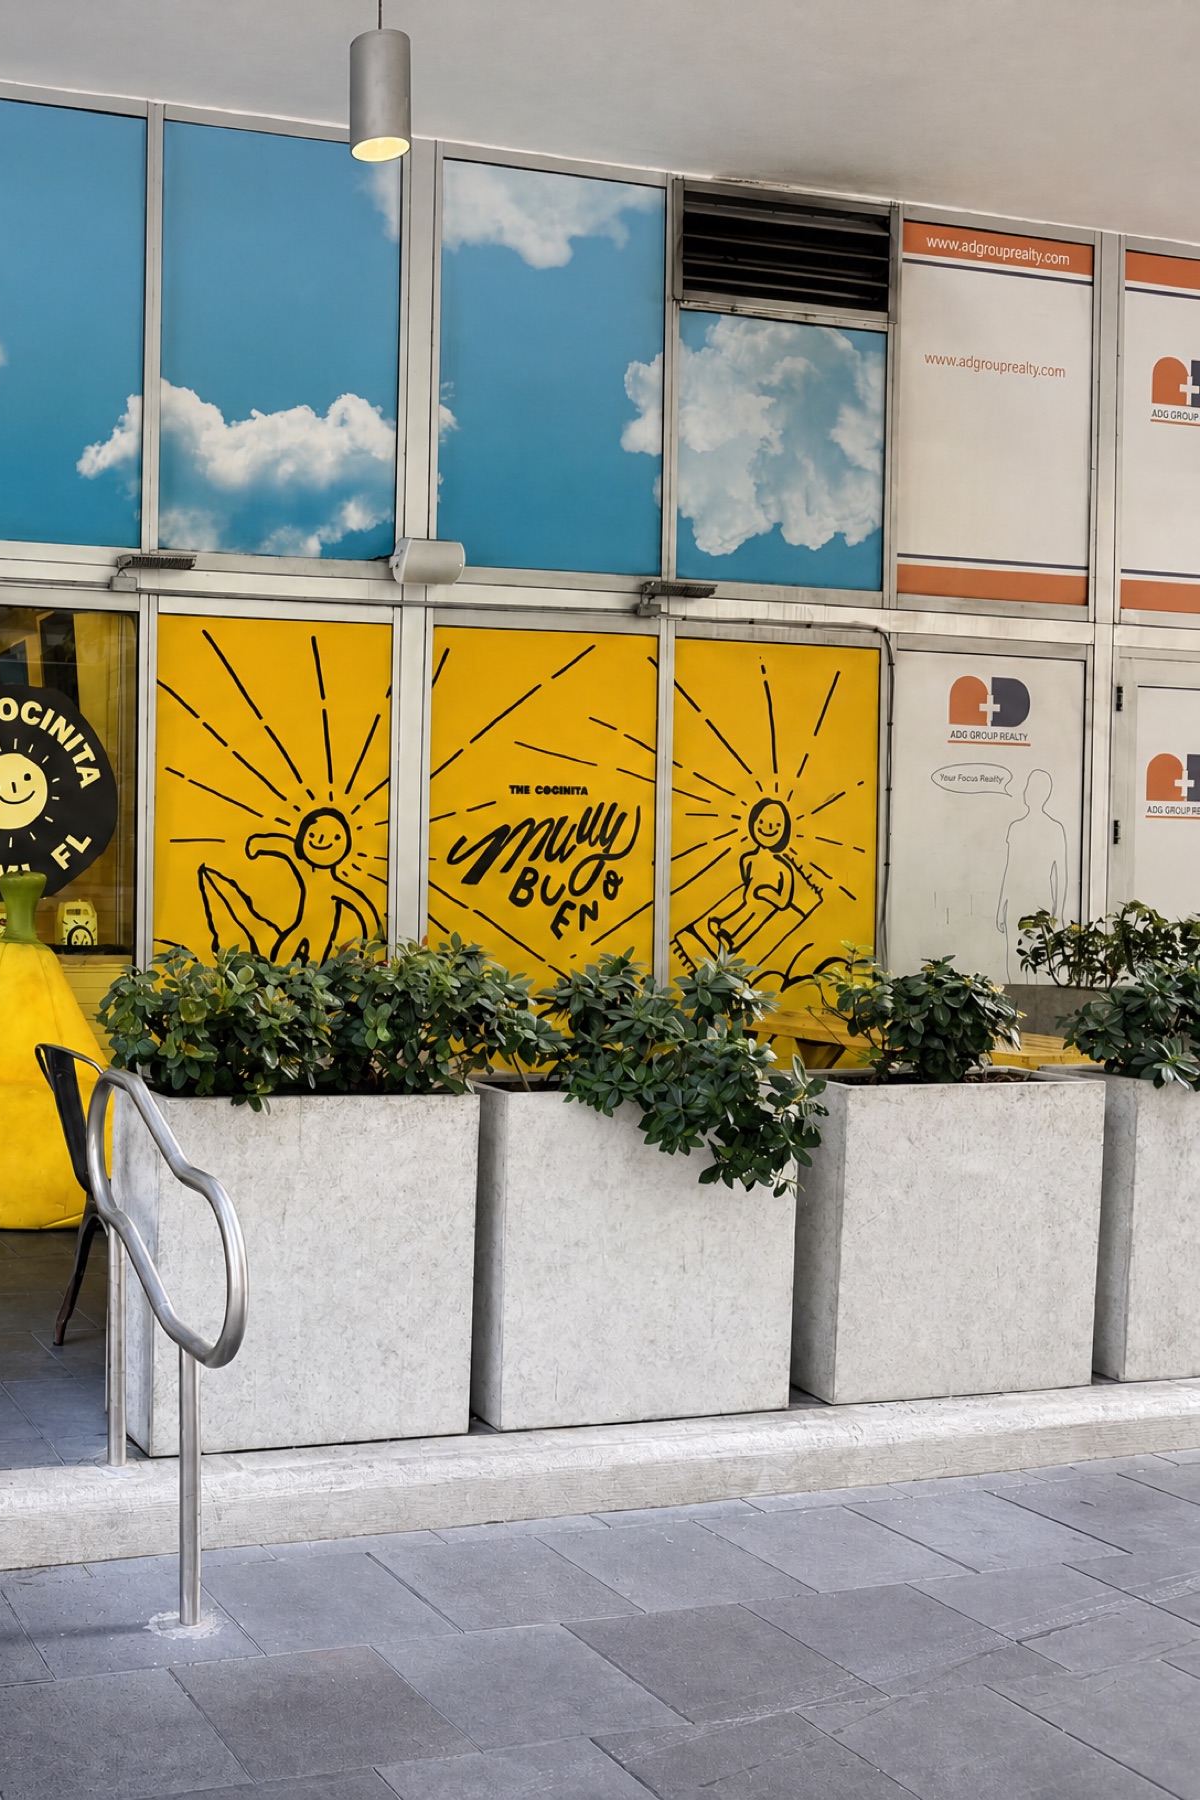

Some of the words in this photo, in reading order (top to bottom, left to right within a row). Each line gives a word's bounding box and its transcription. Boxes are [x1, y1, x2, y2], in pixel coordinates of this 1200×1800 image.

[926, 237, 1070, 266] www.adgrouprealty.com
[924, 353, 1066, 378] www.adgrouprealty.com
[1151, 409, 1169, 419] ADG
[1170, 410, 1199, 421] GROUP
[950, 730, 968, 739] ADG
[970, 731, 998, 741] GROUP
[999, 732, 1028, 741] REALTY
[940, 773, 956, 782] Your
[957, 774, 978, 782] Focus
[979, 775, 1005, 784] Realty
[509, 785, 530, 795] THE
[534, 785, 588, 796] COCINITA
[1147, 806, 1163, 814] ADG
[1165, 806, 1191, 815] GROUP
[51, 834, 92, 870] FL
